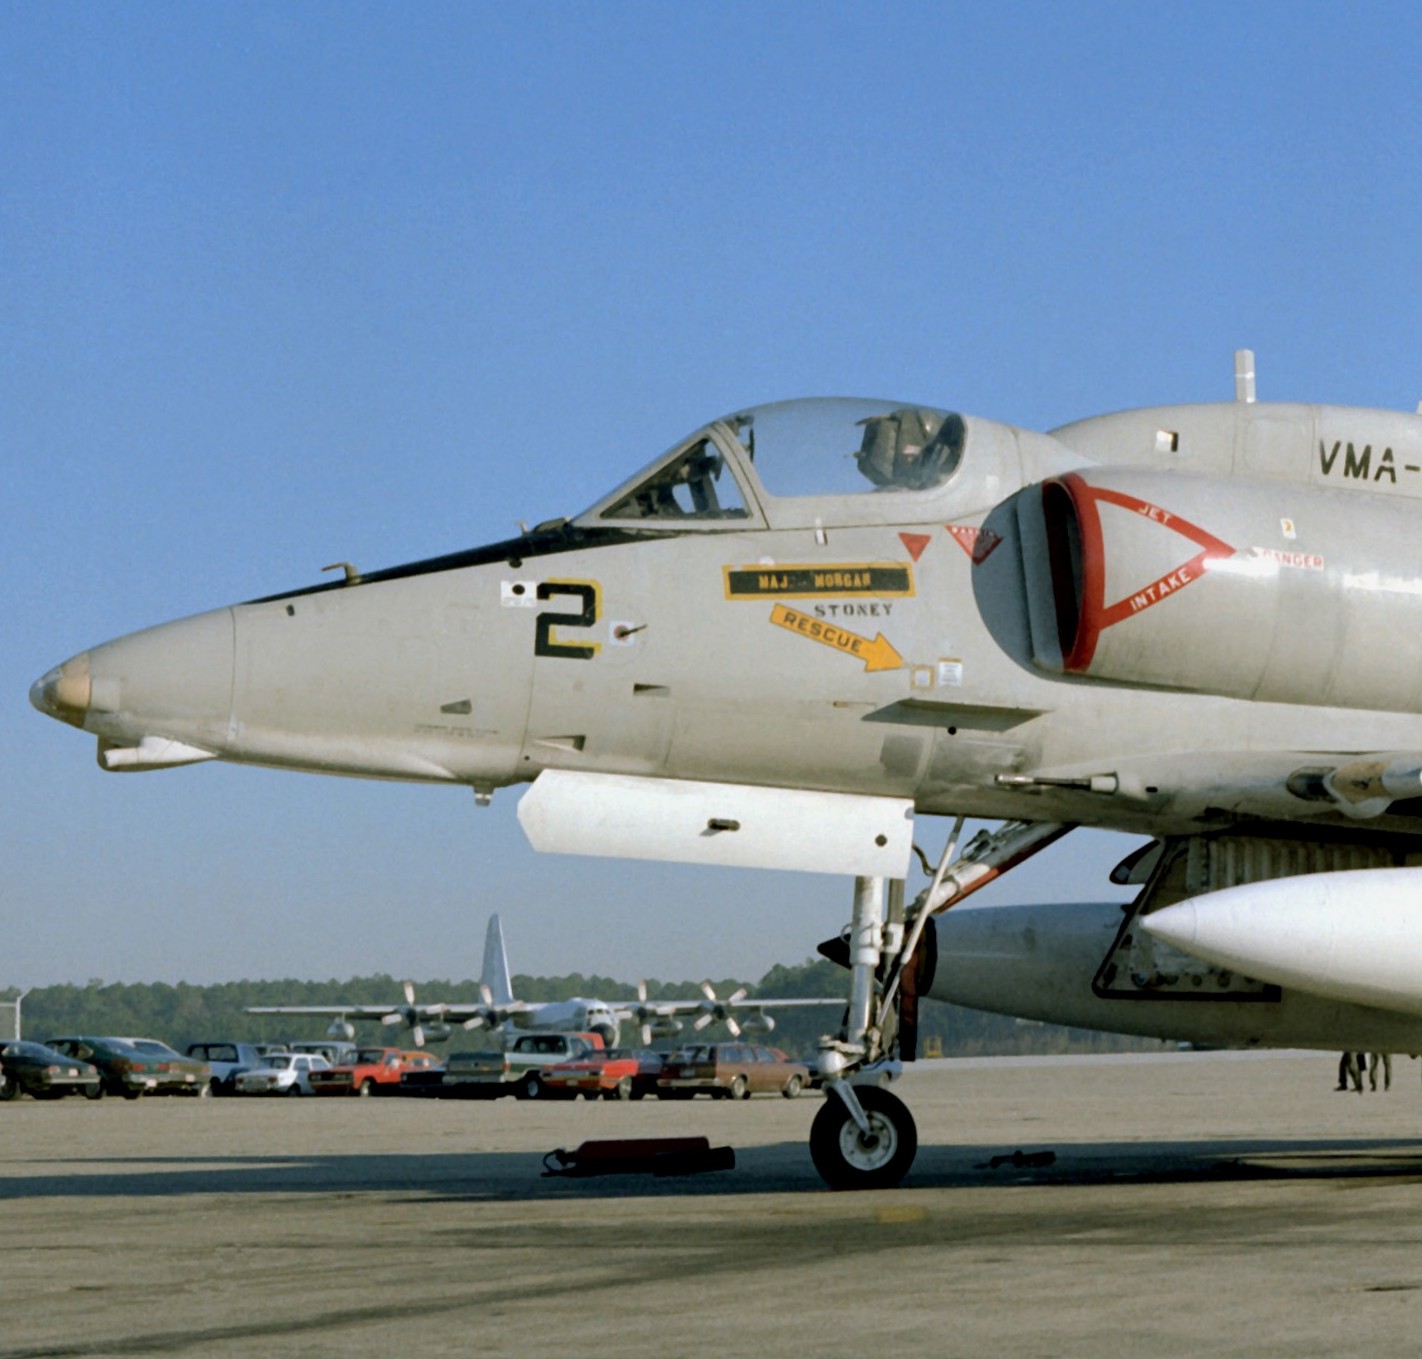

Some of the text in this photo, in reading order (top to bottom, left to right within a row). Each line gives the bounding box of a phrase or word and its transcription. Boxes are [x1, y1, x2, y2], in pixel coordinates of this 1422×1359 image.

[1137, 504, 1172, 526] JET
[814, 572, 872, 588] MORGAN
[1129, 568, 1192, 612] INTAKE
[534, 576, 603, 660] 2
[814, 602, 893, 618] STONEY
[783, 611, 864, 653] RESCUE
